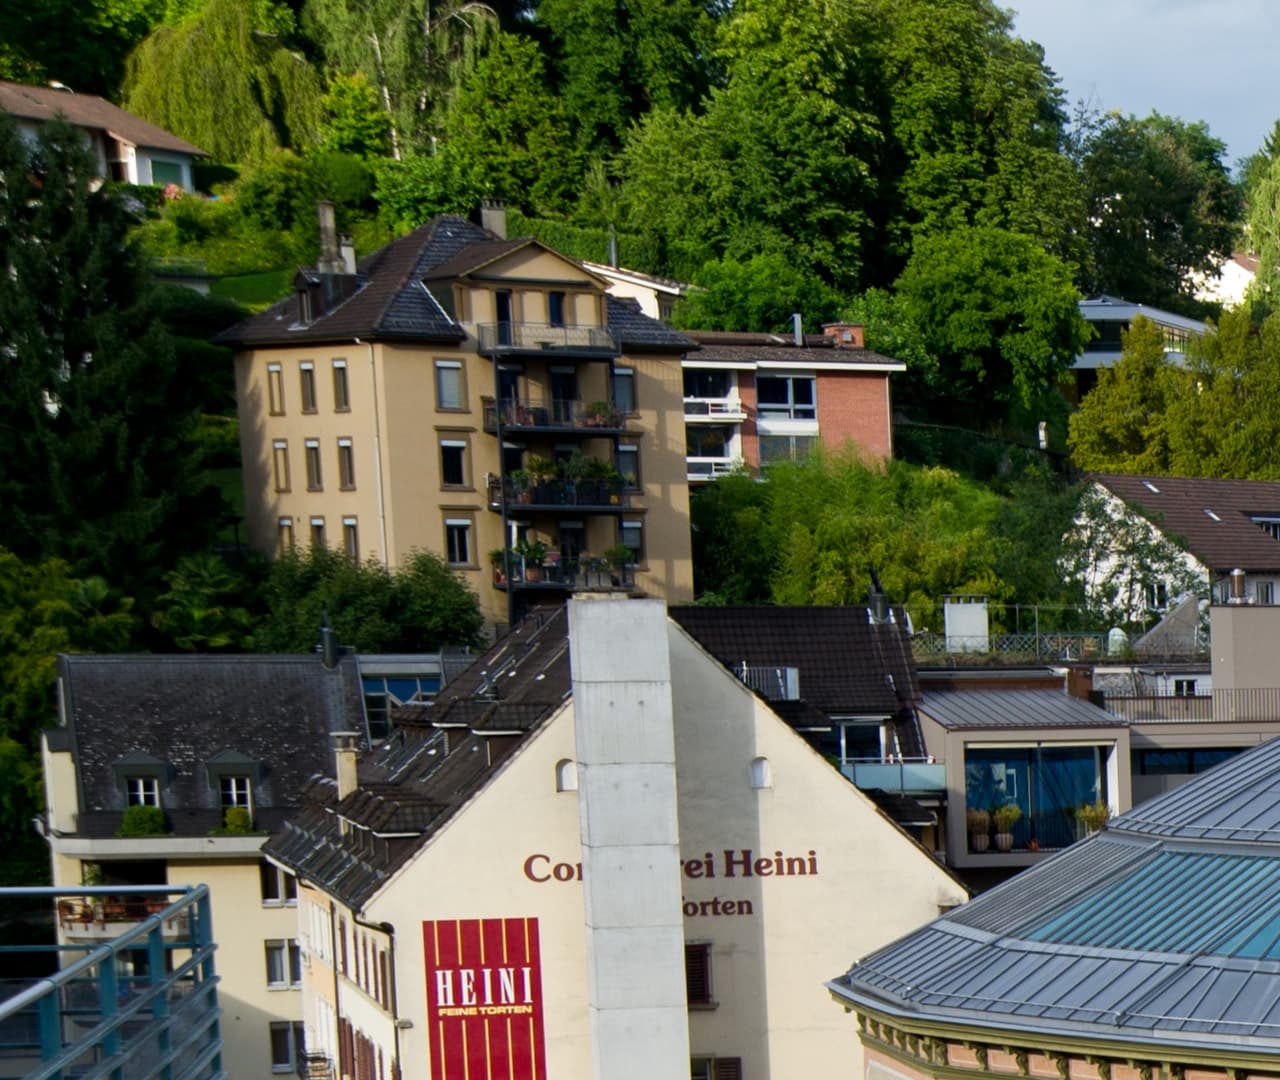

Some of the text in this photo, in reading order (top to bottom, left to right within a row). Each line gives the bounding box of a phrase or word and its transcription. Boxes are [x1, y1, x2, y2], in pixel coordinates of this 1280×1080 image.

[724, 850, 818, 878] Heini
[682, 896, 753, 917] orten
[435, 967, 533, 1006] HEINI
[439, 1005, 532, 1016] FEINE TORTEN
